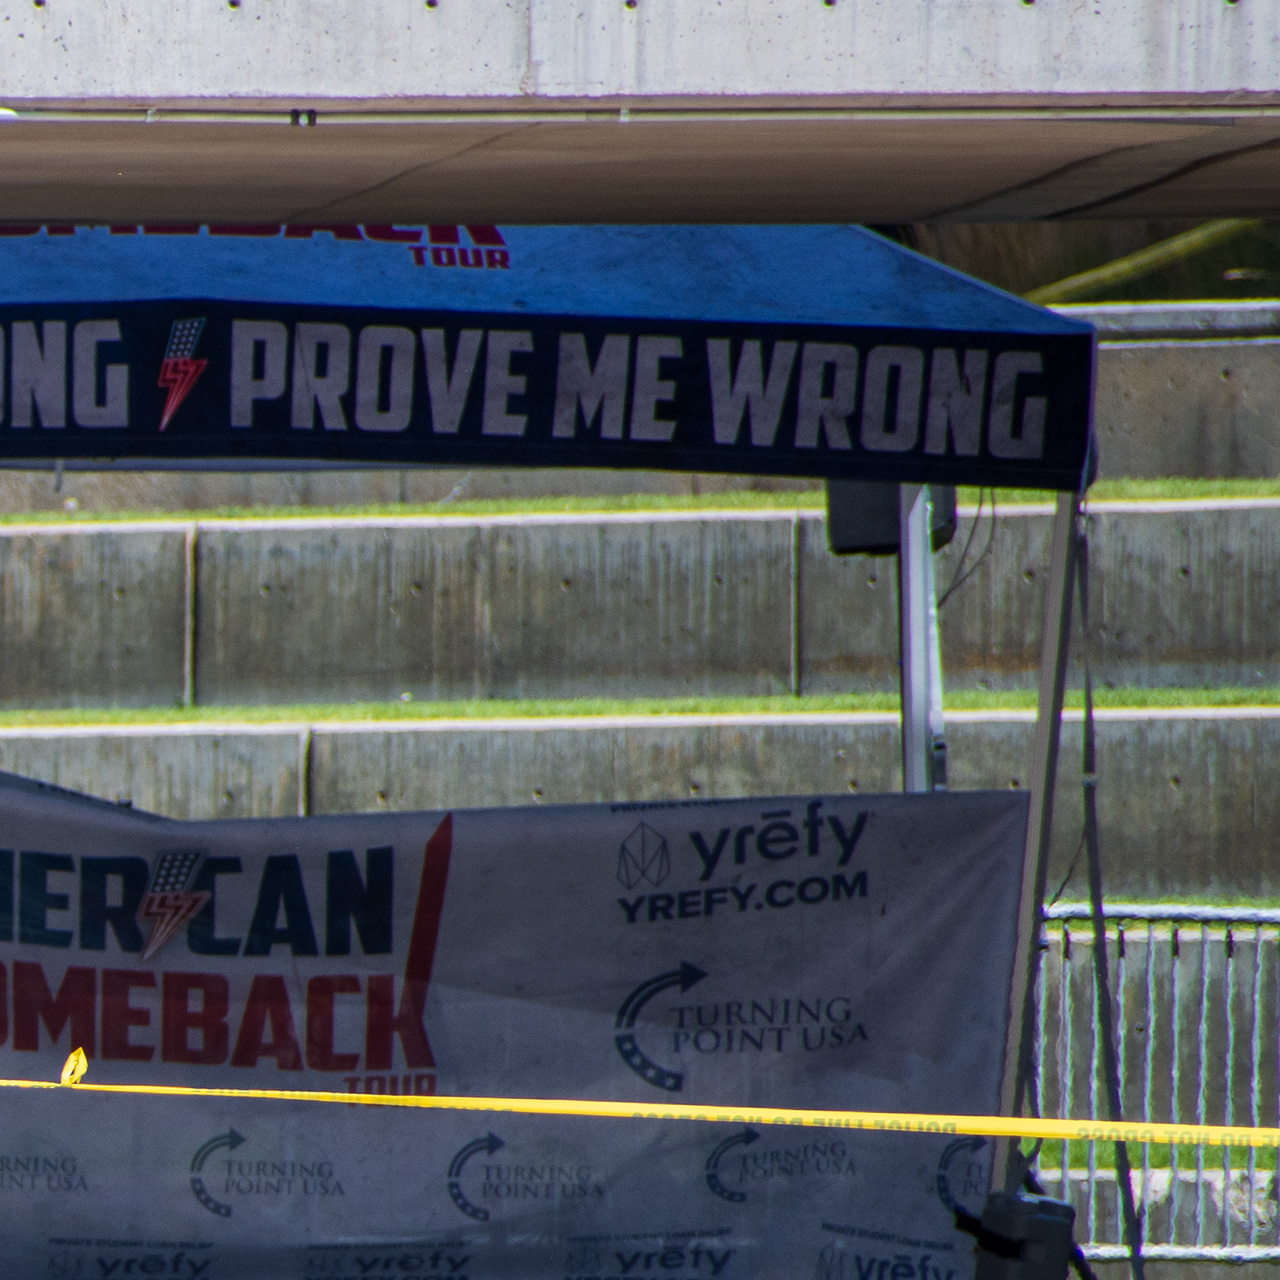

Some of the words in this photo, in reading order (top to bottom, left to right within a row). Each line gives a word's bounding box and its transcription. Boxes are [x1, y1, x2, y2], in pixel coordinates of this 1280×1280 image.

[408, 245, 511, 270] TOUR
[230, 319, 534, 437] PROVE
[551, 331, 683, 441] ME
[706, 337, 1044, 460] WRONG
[617, 870, 868, 923] YREFY.COM
[668, 997, 852, 1029] TURNING
[672, 1026, 791, 1053] POINT
[802, 1022, 869, 1051] USA
[740, 1141, 847, 1168] TURNING
[222, 1159, 333, 1178] TURNING
[481, 1164, 591, 1181] TURNING
[738, 1159, 809, 1182] POINT
[815, 1158, 856, 1176] USA
[46, 1174, 89, 1192] USA
[224, 1178, 297, 1195] POINT
[302, 1179, 345, 1196] USA
[482, 1181, 553, 1199] POINT
[560, 1182, 604, 1199] USA
